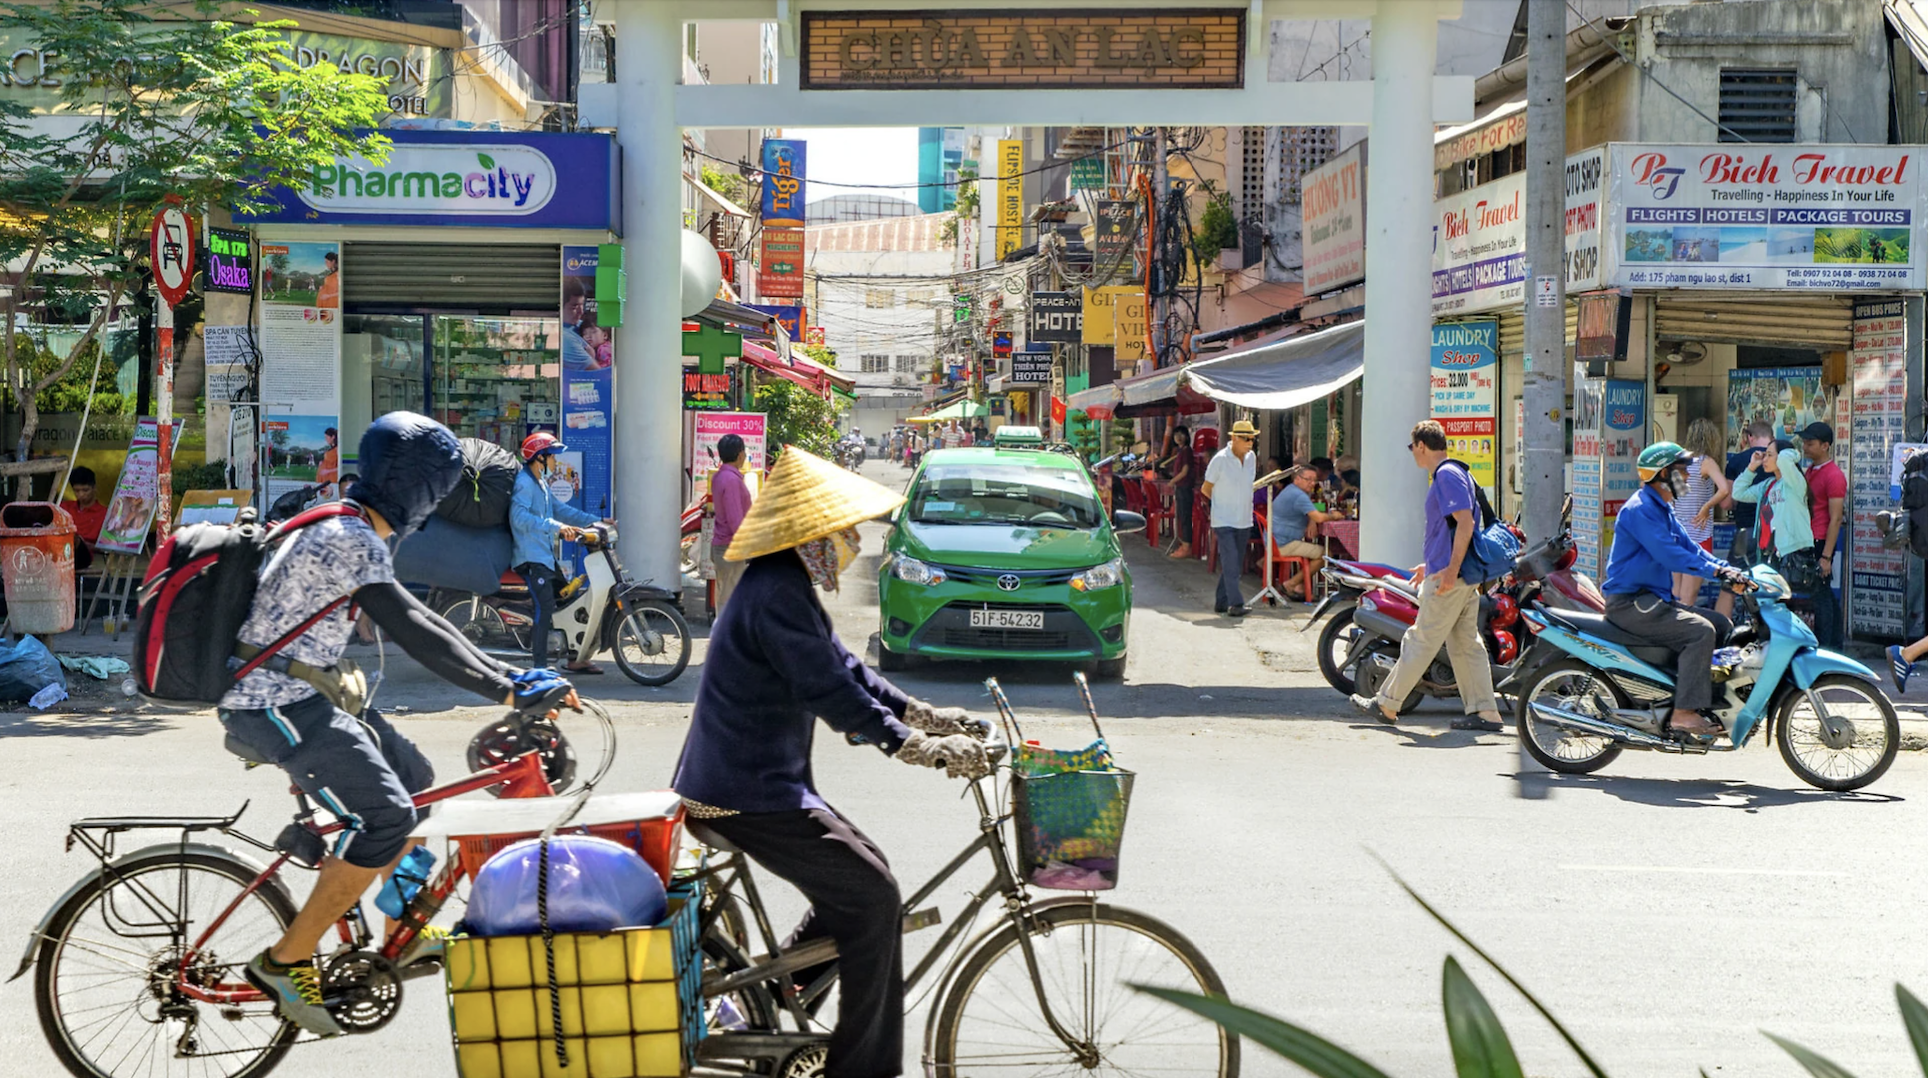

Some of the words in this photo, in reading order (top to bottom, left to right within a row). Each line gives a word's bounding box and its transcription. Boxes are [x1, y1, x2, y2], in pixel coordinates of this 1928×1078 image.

[839, 18, 990, 71] CHÙA
[1001, 28, 1082, 68] AN
[386, 94, 430, 116] OTEL
[1449, 138, 1477, 161] Bike
[1481, 124, 1503, 150] For
[1507, 117, 1525, 139] Re
[1006, 145, 1020, 192] FLIPSIDE
[1581, 157, 1600, 192] SHOP
[1700, 153, 1781, 185] Bich
[1792, 153, 1909, 185] Travel
[312, 164, 535, 206] Pharmacity
[771, 156, 800, 213] Tiger
[1711, 189, 1763, 203] Travelling
[1774, 189, 1828, 203] Happiness
[1831, 189, 1843, 201] In
[1846, 190, 1872, 201] Your
[1874, 189, 1895, 201] Life
[1443, 211, 1470, 241] Bich
[1475, 190, 1519, 230] Travel
[1632, 210, 1696, 222] FLIGHTS
[1706, 210, 1765, 222] HOTELS
[1777, 211, 1847, 223] PACKAGE
[1851, 211, 1905, 223] TOURS
[211, 254, 249, 288] Osaka
[1573, 246, 1598, 283] SHOP
[1451, 269, 1472, 291] HOTELS
[1475, 261, 1507, 286] PACKAGE
[1629, 272, 1647, 282] Add:
[1649, 272, 1663, 282] 175
[1665, 273, 1686, 285] pham
[1688, 275, 1703, 285] ngu
[1704, 273, 1716, 283] lao
[1730, 273, 1744, 283] dist
[1745, 273, 1751, 283] 1
[1803, 270, 1821, 278] 0907
[1786, 279, 1808, 288] Email:
[1126, 305, 1145, 318] GI
[1856, 306, 1871, 317] OPEN
[1871, 305, 1883, 316] BUS
[1884, 302, 1901, 314] PRICE
[1035, 312, 1082, 331] HOTE
[1432, 329, 1491, 347] LAUNDRY
[1442, 350, 1480, 366] Shop
[1449, 372, 1468, 388] 32.000
[1435, 391, 1445, 400] PICK
[1608, 388, 1642, 405] LAUNDRY
[697, 417, 740, 430] Discount
[743, 420, 763, 431] 30%
[1446, 421, 1473, 432] PASSPORT
[1474, 421, 1492, 432] PHOTO
[1612, 409, 1635, 428] Shop
[136, 426, 157, 439] Discou
[1854, 573, 1869, 586] BOAT
[1870, 575, 1887, 588] TICKET
